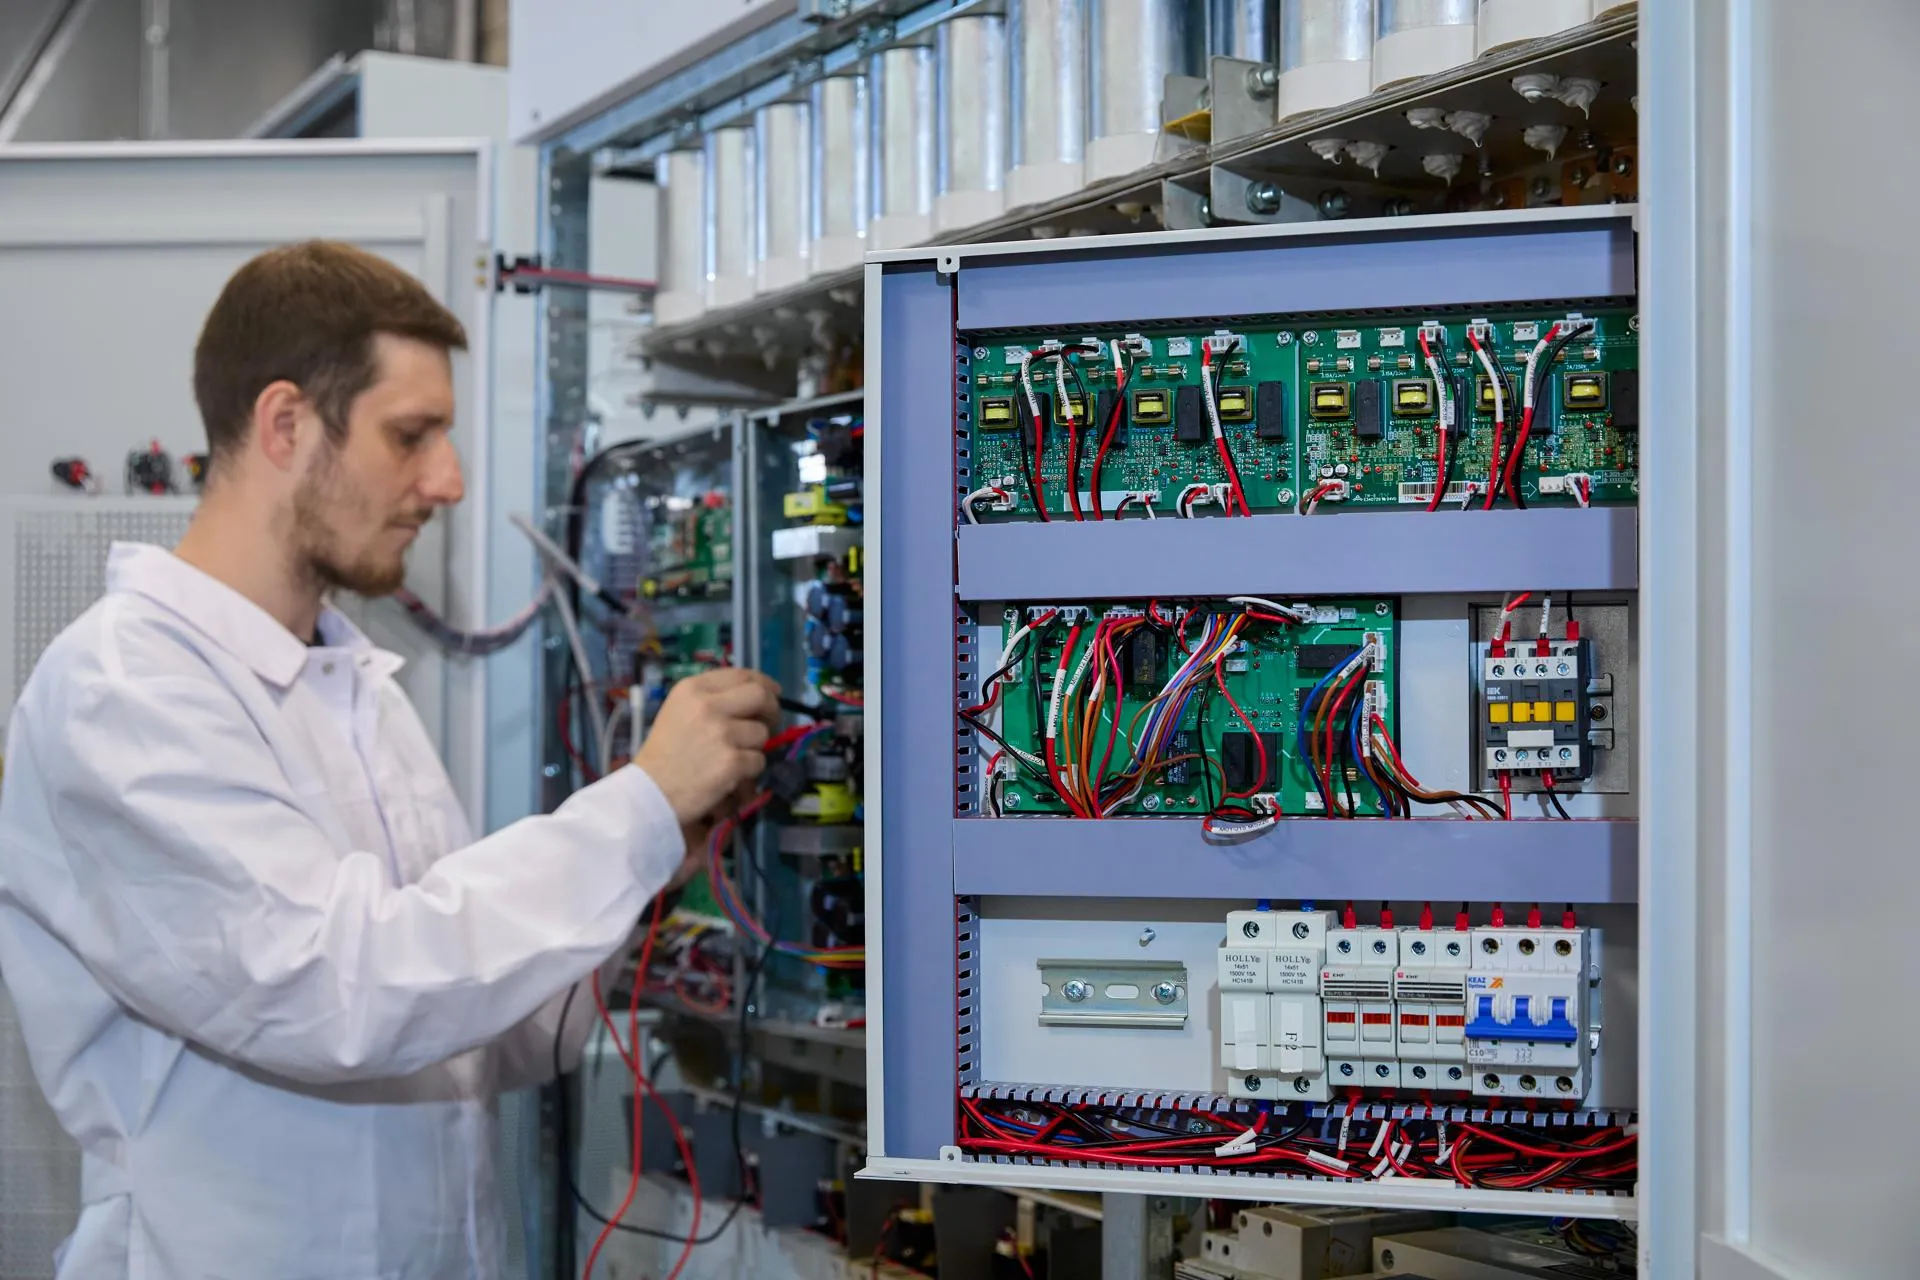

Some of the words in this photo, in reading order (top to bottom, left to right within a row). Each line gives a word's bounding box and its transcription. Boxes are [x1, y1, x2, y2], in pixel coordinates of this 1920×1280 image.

[1468, 1048, 1485, 1057] C10
[1499, 1084, 1506, 1093] 2
[1536, 1086, 1542, 1094] 4
[1572, 1087, 1579, 1095] 6
